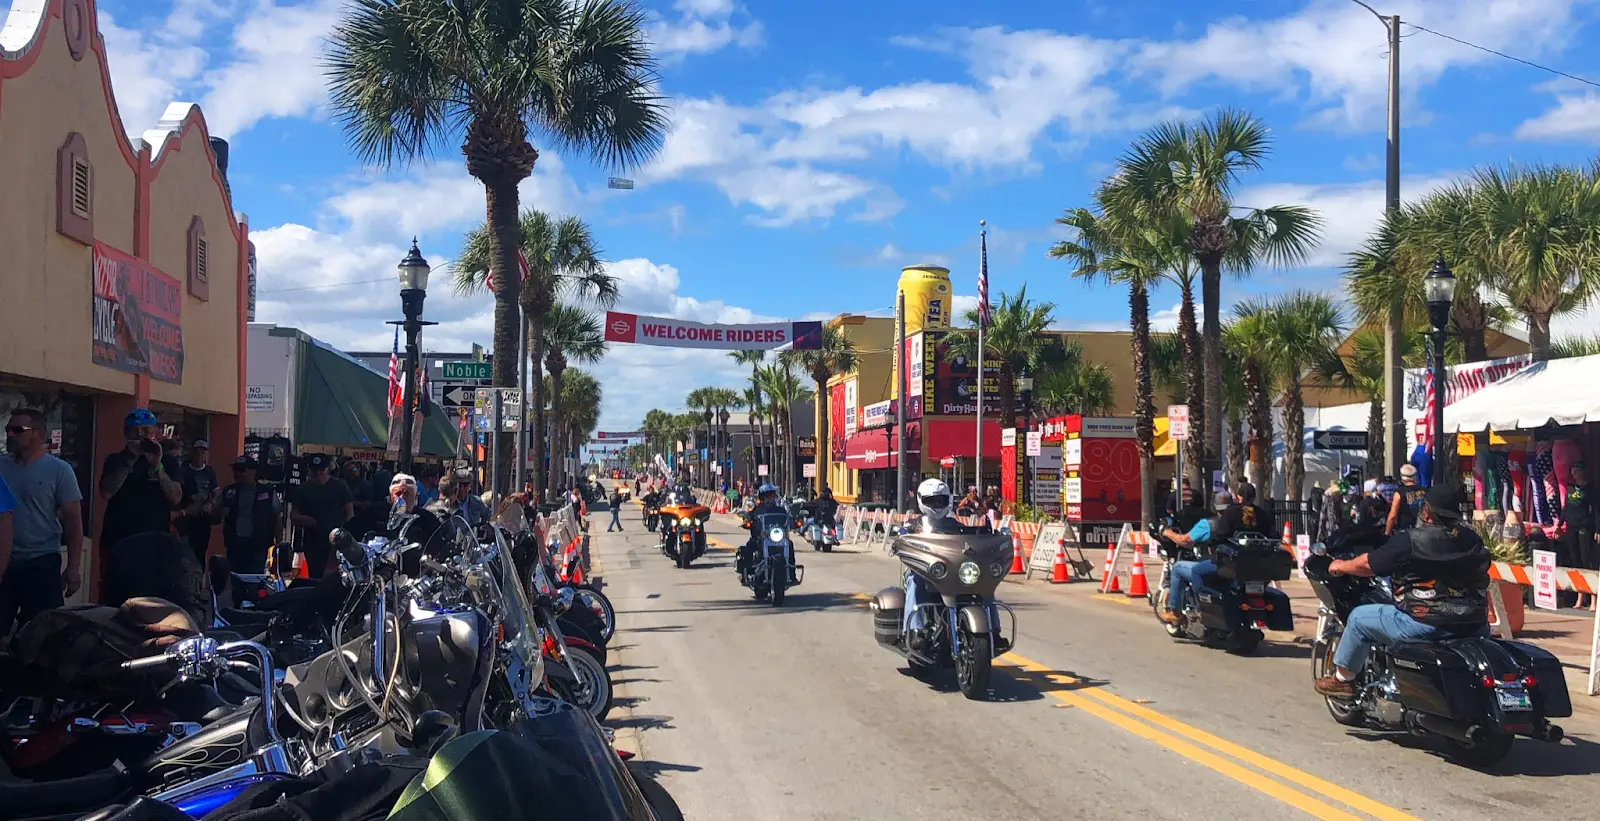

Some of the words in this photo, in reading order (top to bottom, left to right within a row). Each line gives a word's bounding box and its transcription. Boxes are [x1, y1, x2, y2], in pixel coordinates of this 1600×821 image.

[927, 299, 941, 323] TEA
[94, 297, 119, 345] CYCLE
[641, 323, 723, 343] WELCOME
[726, 329, 786, 343] RIDERS
[925, 334, 935, 376] WEEK
[966, 360, 1004, 368] JAMINE
[446, 364, 486, 377] Noble
[968, 385, 1000, 393] COTES
[463, 391, 475, 400] ON
[925, 379, 935, 413] BIKE
[943, 403, 992, 414] DirtyHary's
[800, 440, 815, 448] Bank
[353, 452, 377, 460] OPEN
[1082, 440, 1141, 483] 80
[1017, 465, 1023, 473] OF
[1093, 526, 1107, 534] Dirty
[1536, 564, 1553, 572] PARKING
[1540, 581, 1550, 589] TIME
